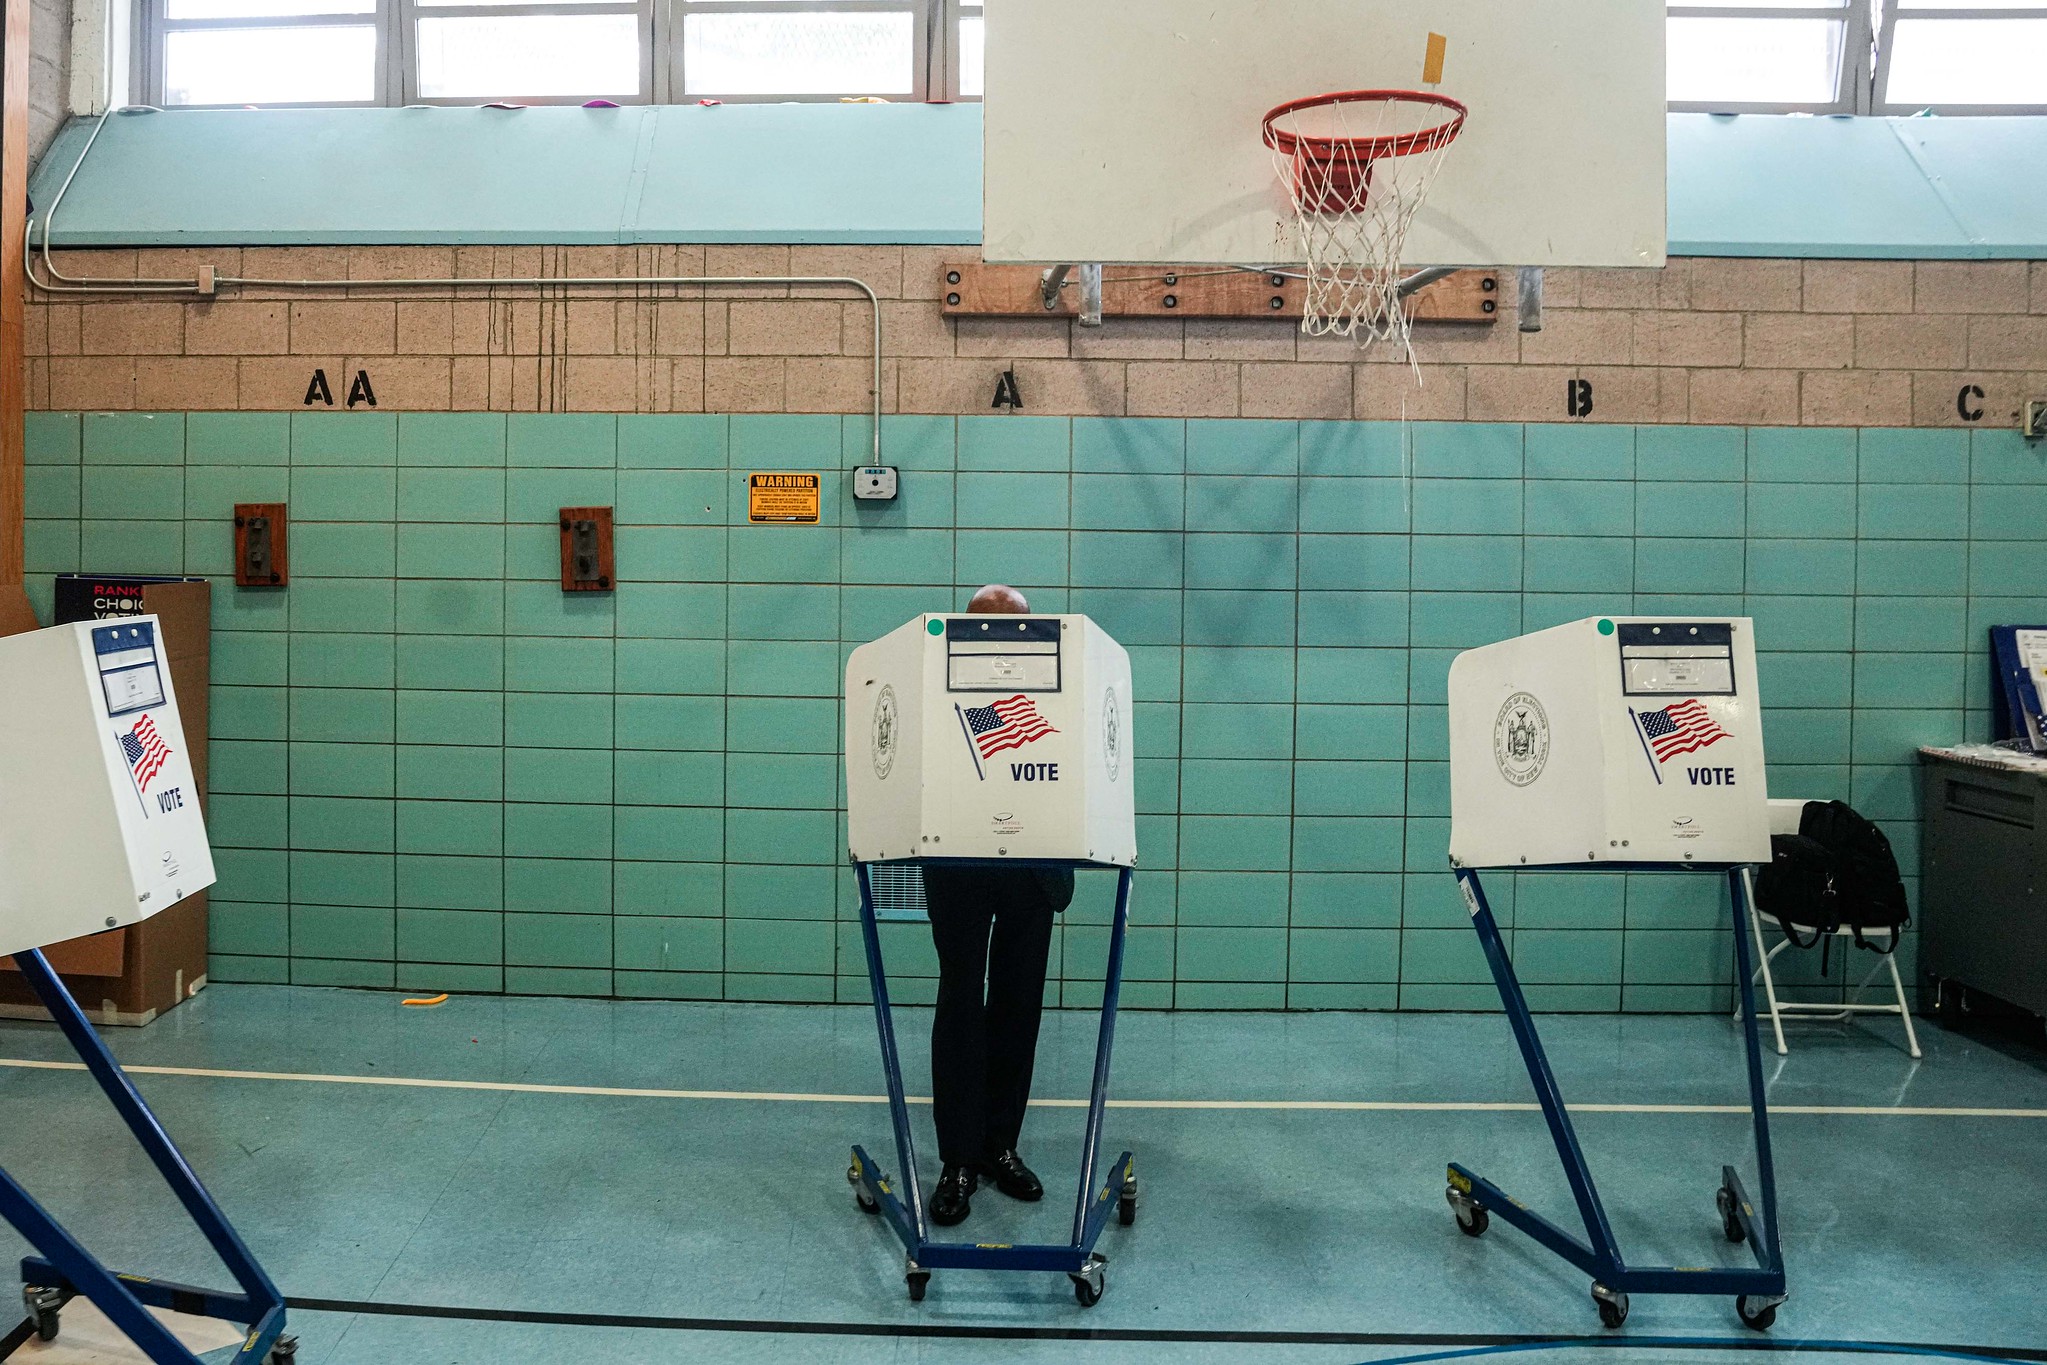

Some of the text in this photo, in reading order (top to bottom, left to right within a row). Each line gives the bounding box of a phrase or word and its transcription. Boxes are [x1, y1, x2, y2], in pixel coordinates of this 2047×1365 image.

[991, 370, 1024, 408] A
[1567, 379, 1594, 418] B
[1957, 384, 1985, 421] C
[755, 475, 814, 487] WARNING
[1010, 763, 1059, 782] VOTE
[1686, 767, 1736, 786] VOTE
[156, 787, 184, 814] VOTE
